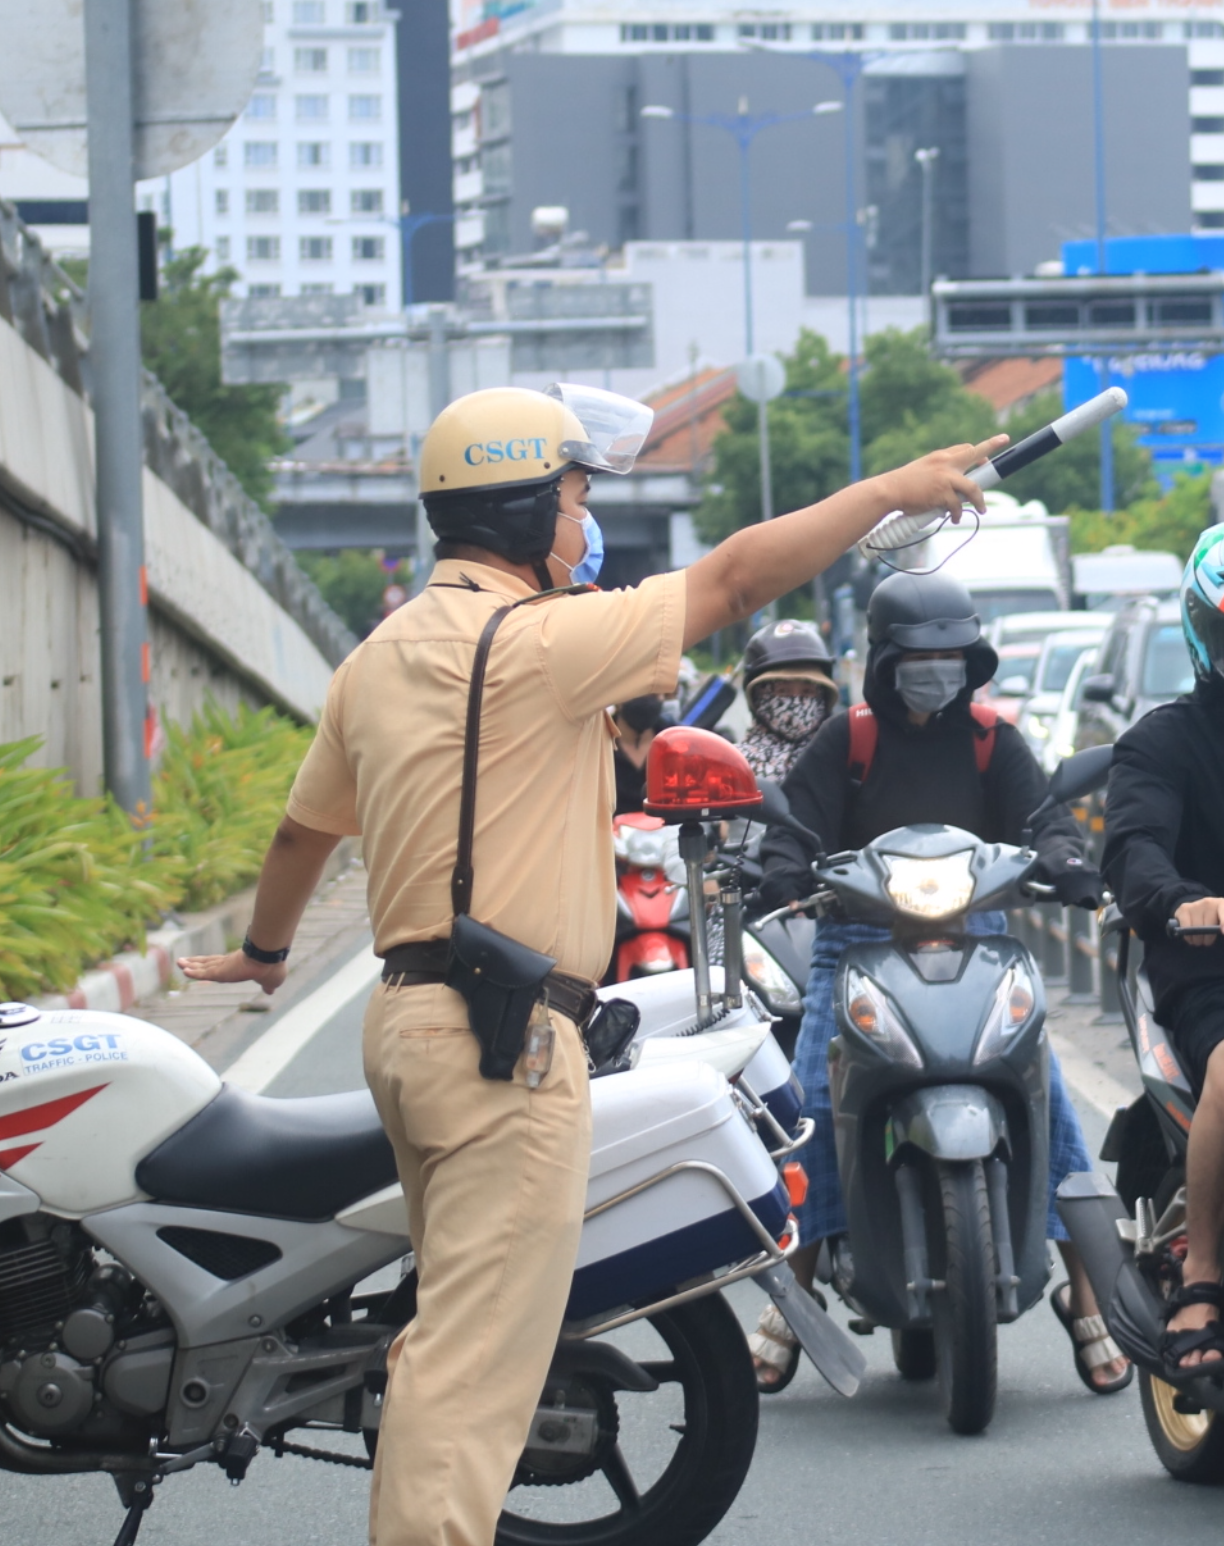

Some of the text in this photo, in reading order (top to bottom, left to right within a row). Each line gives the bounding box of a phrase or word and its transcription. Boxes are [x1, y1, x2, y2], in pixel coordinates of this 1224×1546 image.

[464, 437, 547, 467] CSGT
[21, 1034, 121, 1062] CSGT
[25, 1057, 75, 1074] TRAFFIC
[85, 1051, 128, 1062] POLICE
